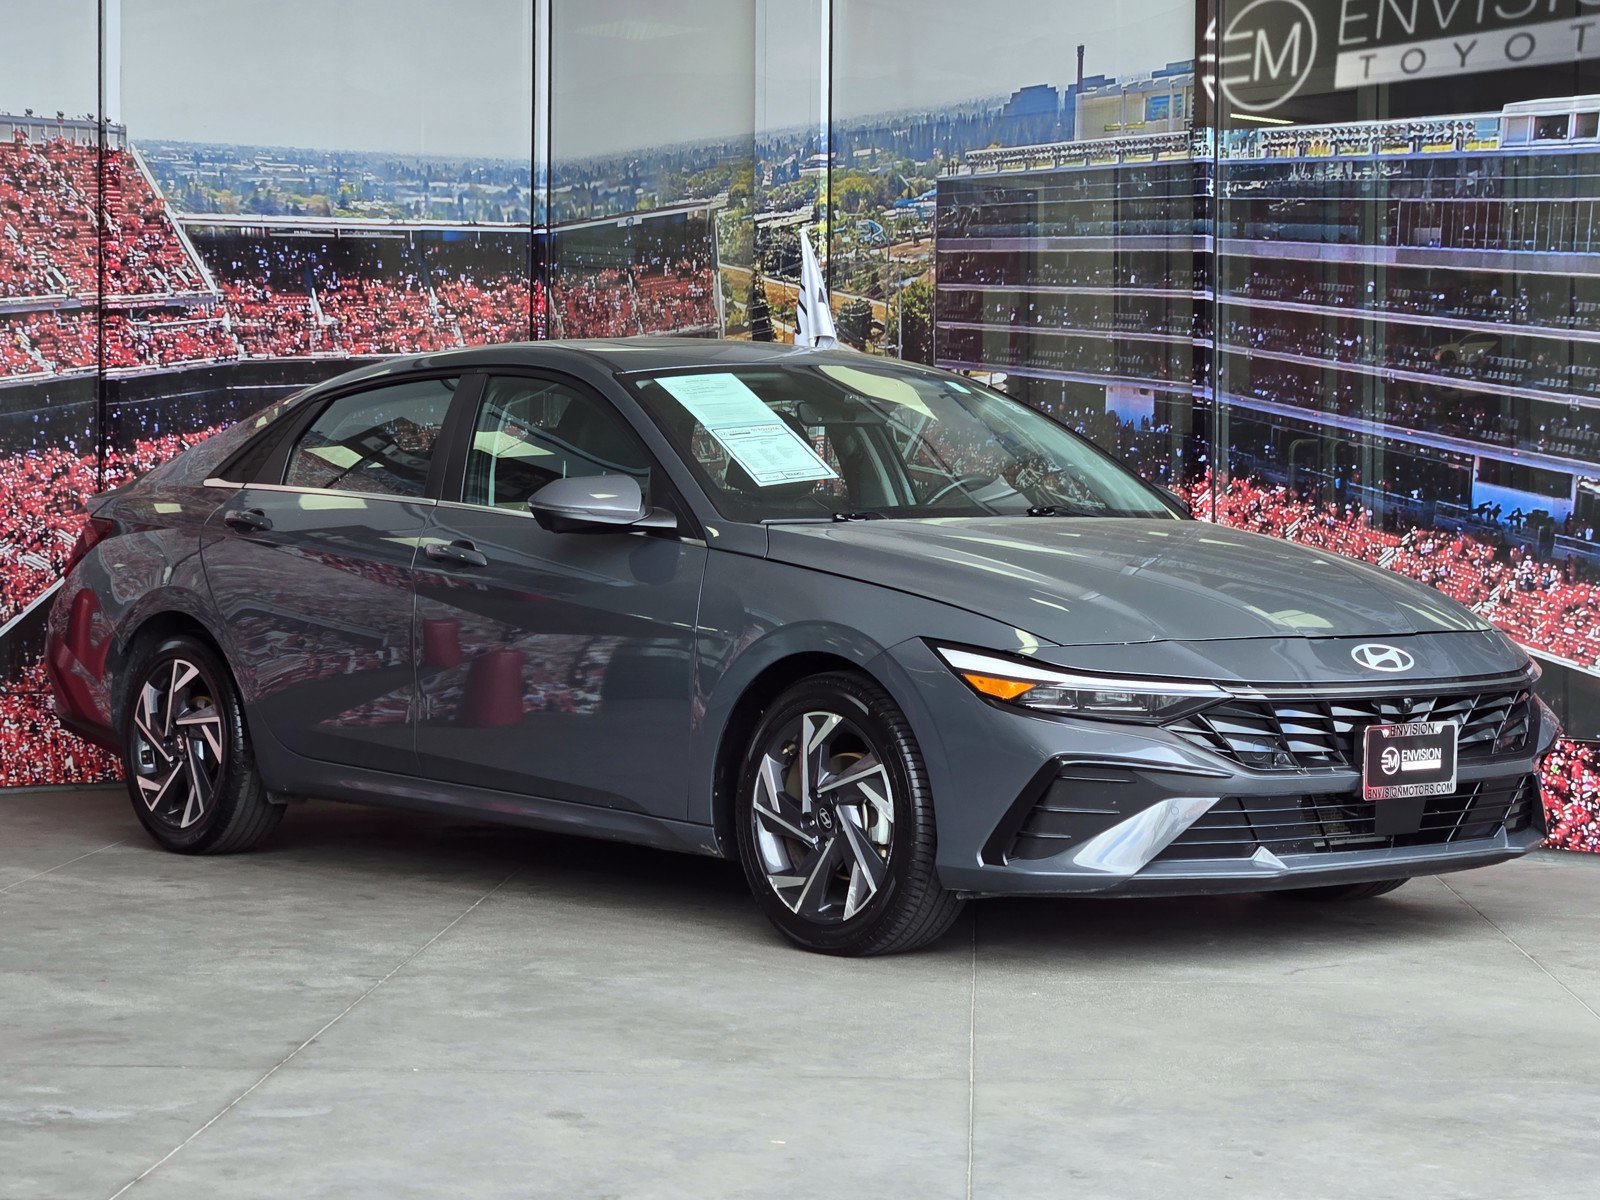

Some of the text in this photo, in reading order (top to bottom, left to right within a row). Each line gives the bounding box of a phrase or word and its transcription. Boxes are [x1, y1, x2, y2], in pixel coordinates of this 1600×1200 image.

[1390, 723, 1435, 737] ENVISION
[1401, 748, 1442, 762] ENVISION
[1367, 783, 1453, 799] ENVISIONMOTORS.COM
